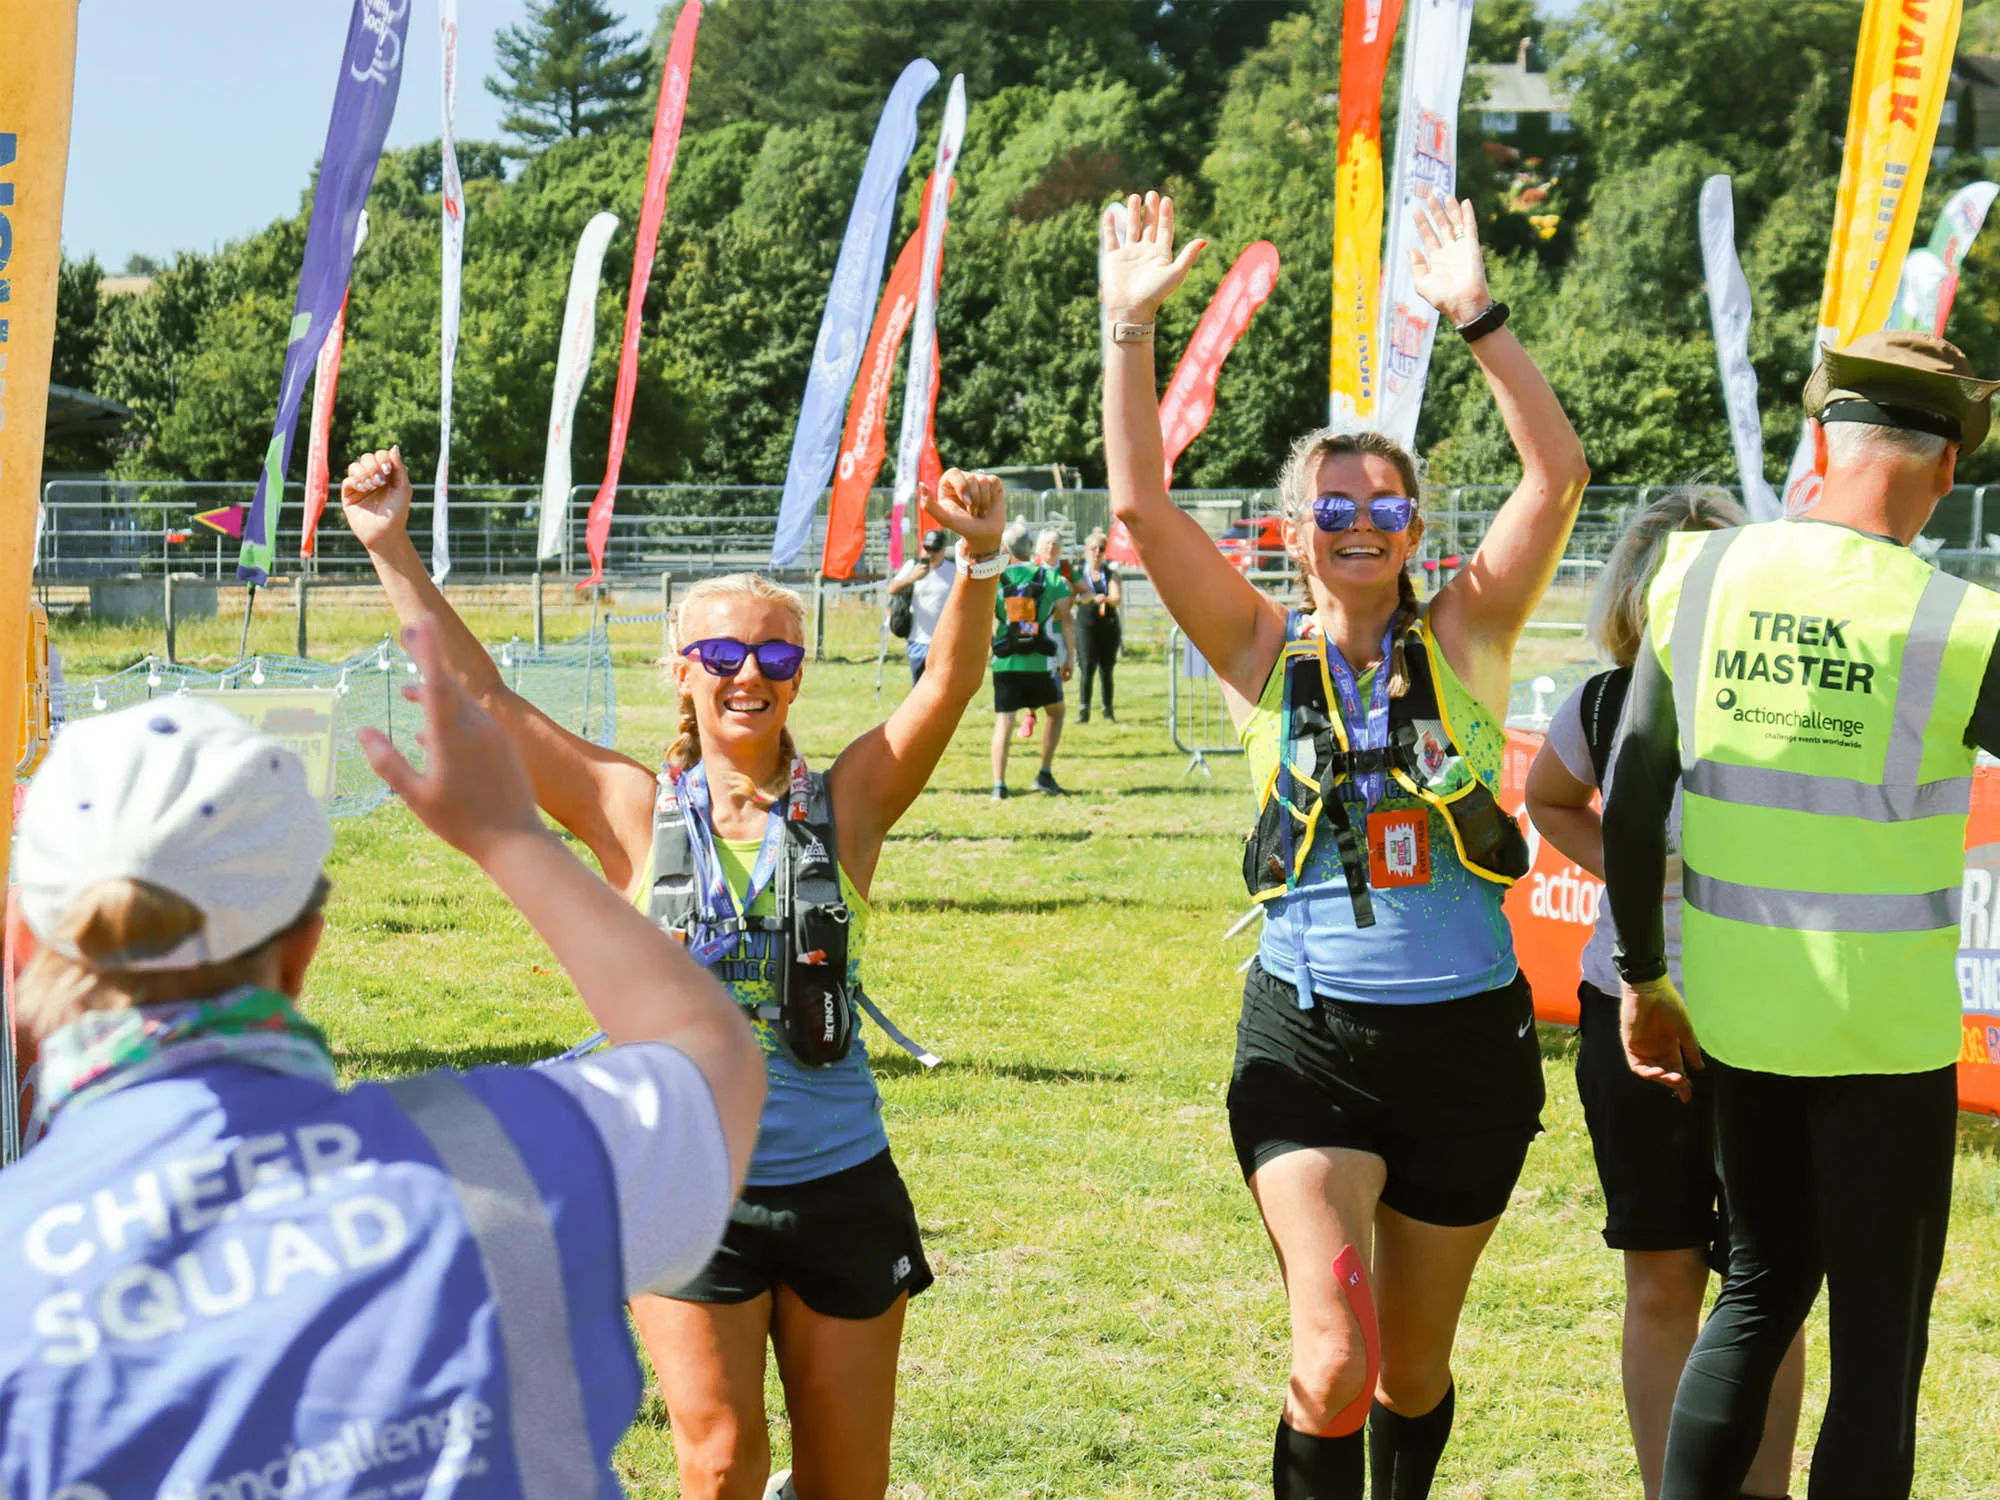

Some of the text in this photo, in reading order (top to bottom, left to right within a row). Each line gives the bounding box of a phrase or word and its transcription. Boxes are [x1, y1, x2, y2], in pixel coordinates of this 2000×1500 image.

[1749, 611, 1852, 649] TREK
[1714, 649, 1875, 694] MASTER
[1733, 707, 1864, 738] actionchallenge
[1798, 736, 1821, 745] events
[24, 1123, 380, 1276] CHEER
[33, 1196, 408, 1367] SQUAD
